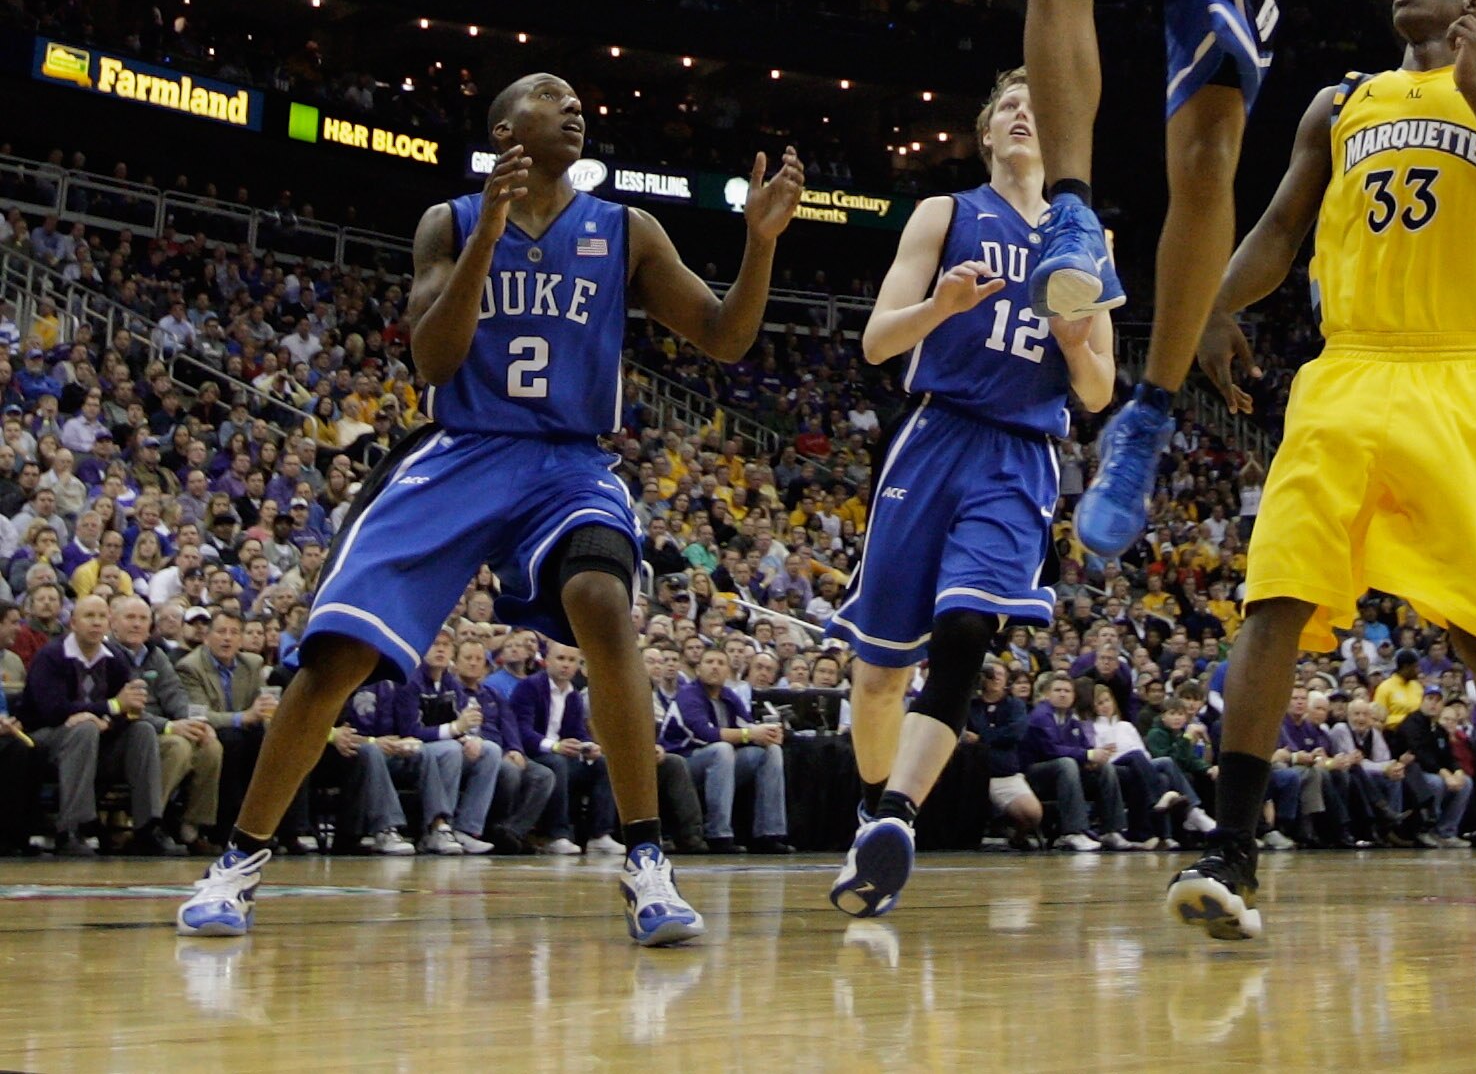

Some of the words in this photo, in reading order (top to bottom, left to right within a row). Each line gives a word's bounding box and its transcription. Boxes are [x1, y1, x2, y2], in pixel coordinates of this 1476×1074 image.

[97, 55, 249, 126] Farmland
[1405, 87, 1423, 99] AL
[324, 116, 368, 150] H&R
[372, 126, 438, 165] BLOCK
[471, 151, 501, 173] GRE
[614, 169, 645, 193] LESS
[831, 189, 892, 217] Century
[1364, 167, 1441, 234] 33
[980, 240, 1029, 284] DU
[984, 298, 1050, 365] 12
[506, 336, 549, 398] 2
[398, 475, 431, 486] ACC
[882, 488, 908, 501] ACC
